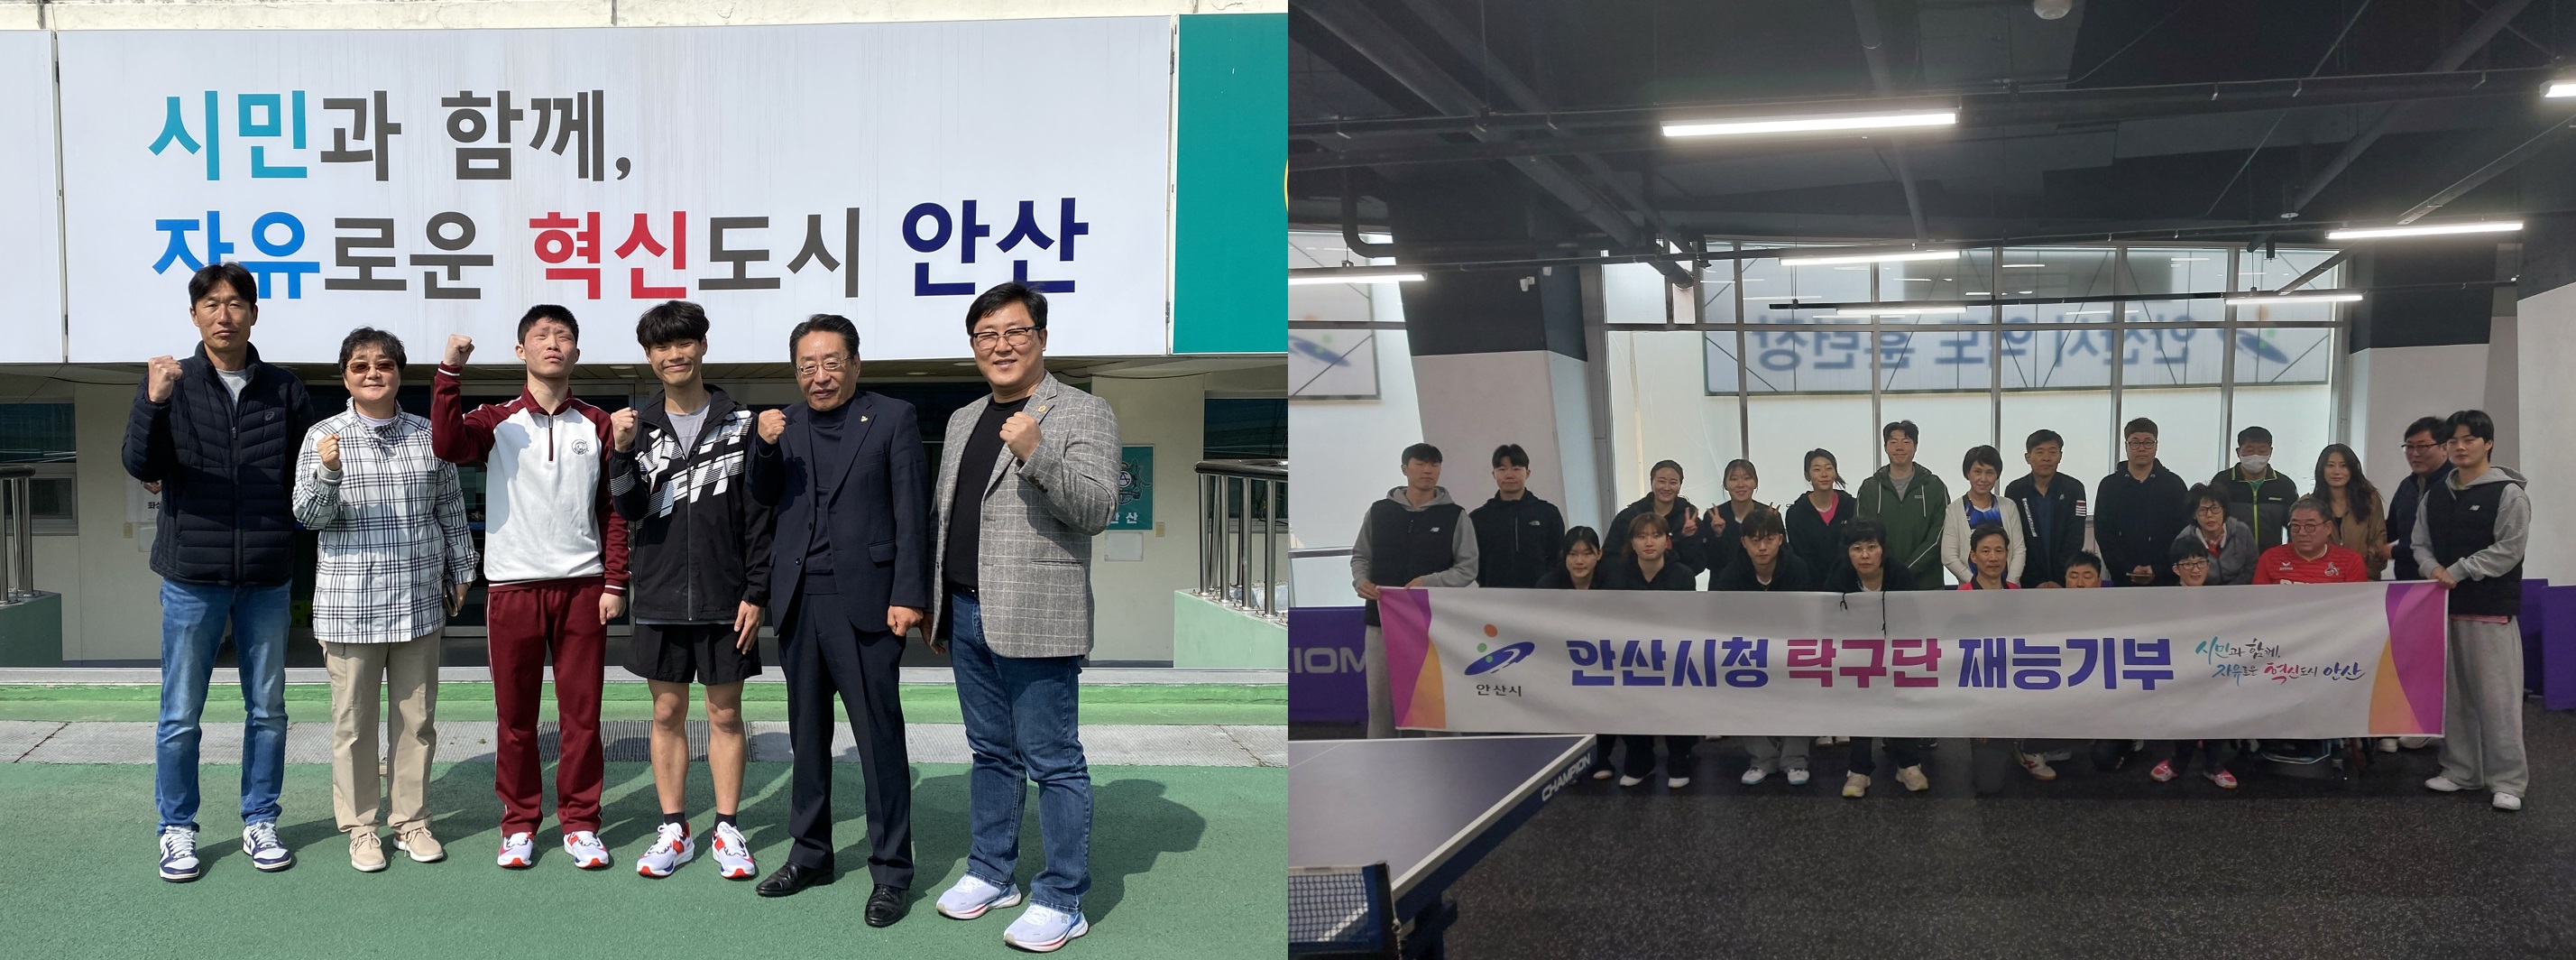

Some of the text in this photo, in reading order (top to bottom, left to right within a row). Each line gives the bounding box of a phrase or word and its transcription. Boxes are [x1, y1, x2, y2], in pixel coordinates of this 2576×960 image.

[149, 90, 631, 181] 시민과 함께,
[152, 198, 1089, 300] 자유로운 혁신도시 안산
[1288, 638, 1366, 674] IOM
[1567, 637, 2174, 691] 안산시청 탁구단 재능기부
[2195, 636, 2246, 665] 시민과
[1476, 684, 1523, 697] 안산시
[2212, 661, 2367, 687] 자유로운 혁신도시 안산
[1541, 752, 1591, 801] CHAMPION
